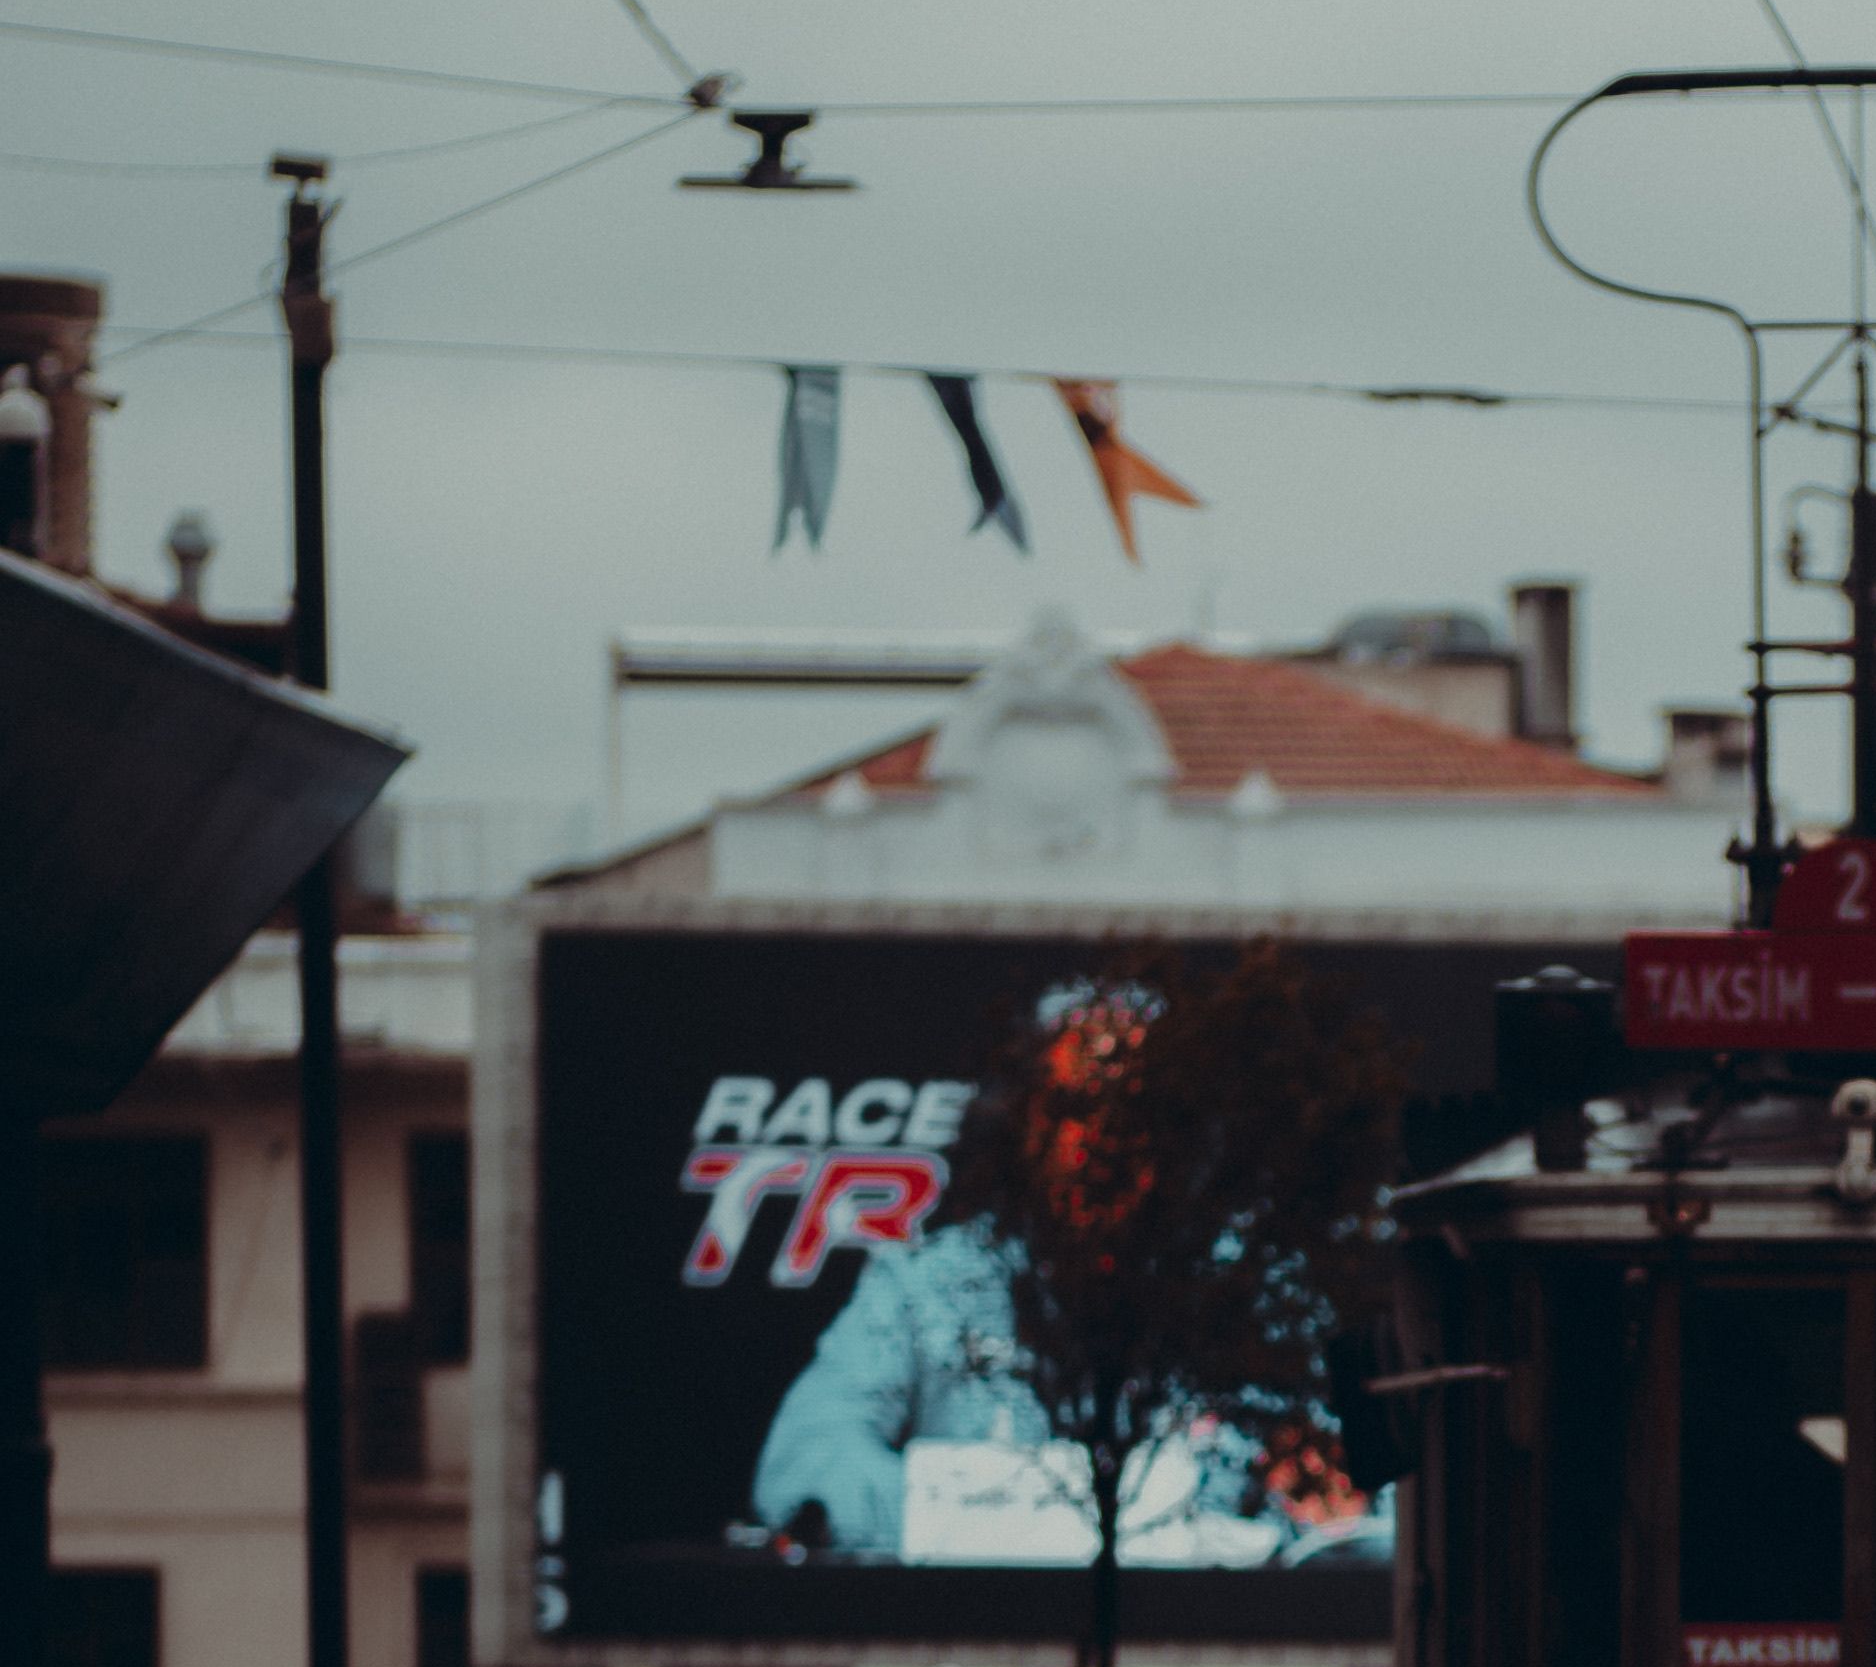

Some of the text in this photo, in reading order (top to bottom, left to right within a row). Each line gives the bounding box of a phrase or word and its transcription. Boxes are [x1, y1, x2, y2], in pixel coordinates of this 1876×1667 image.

[1836, 850, 1869, 922] 2
[1641, 947, 1813, 1023] TAKSİM
[693, 1075, 980, 1146] RACE
[679, 1144, 952, 1288] TR
[1685, 1630, 1841, 1667] TAKSİM
